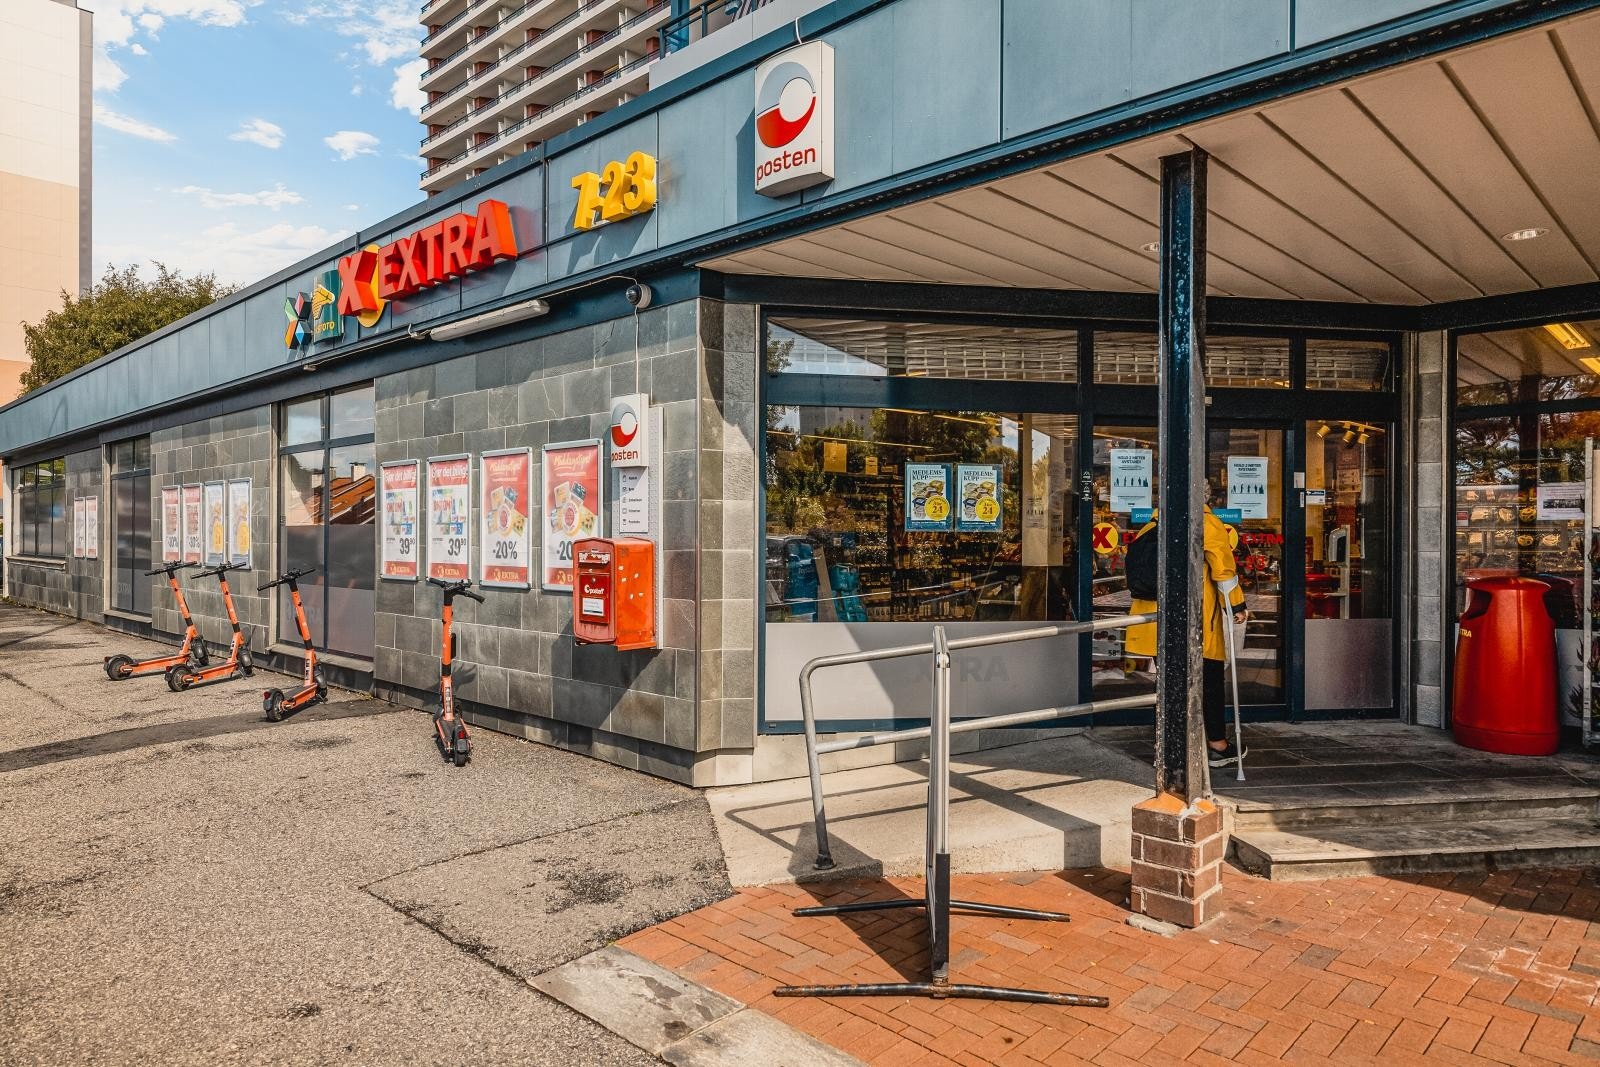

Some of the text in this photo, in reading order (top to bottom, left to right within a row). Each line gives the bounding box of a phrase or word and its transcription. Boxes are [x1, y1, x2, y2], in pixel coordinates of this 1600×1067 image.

[756, 147, 816, 186] posten
[378, 199, 518, 300] EXTRA
[1242, 533, 1284, 545] EXTRA
[492, 540, 518, 560] -20%
[556, 540, 574, 561] -20
[501, 570, 519, 580] EXTRA
